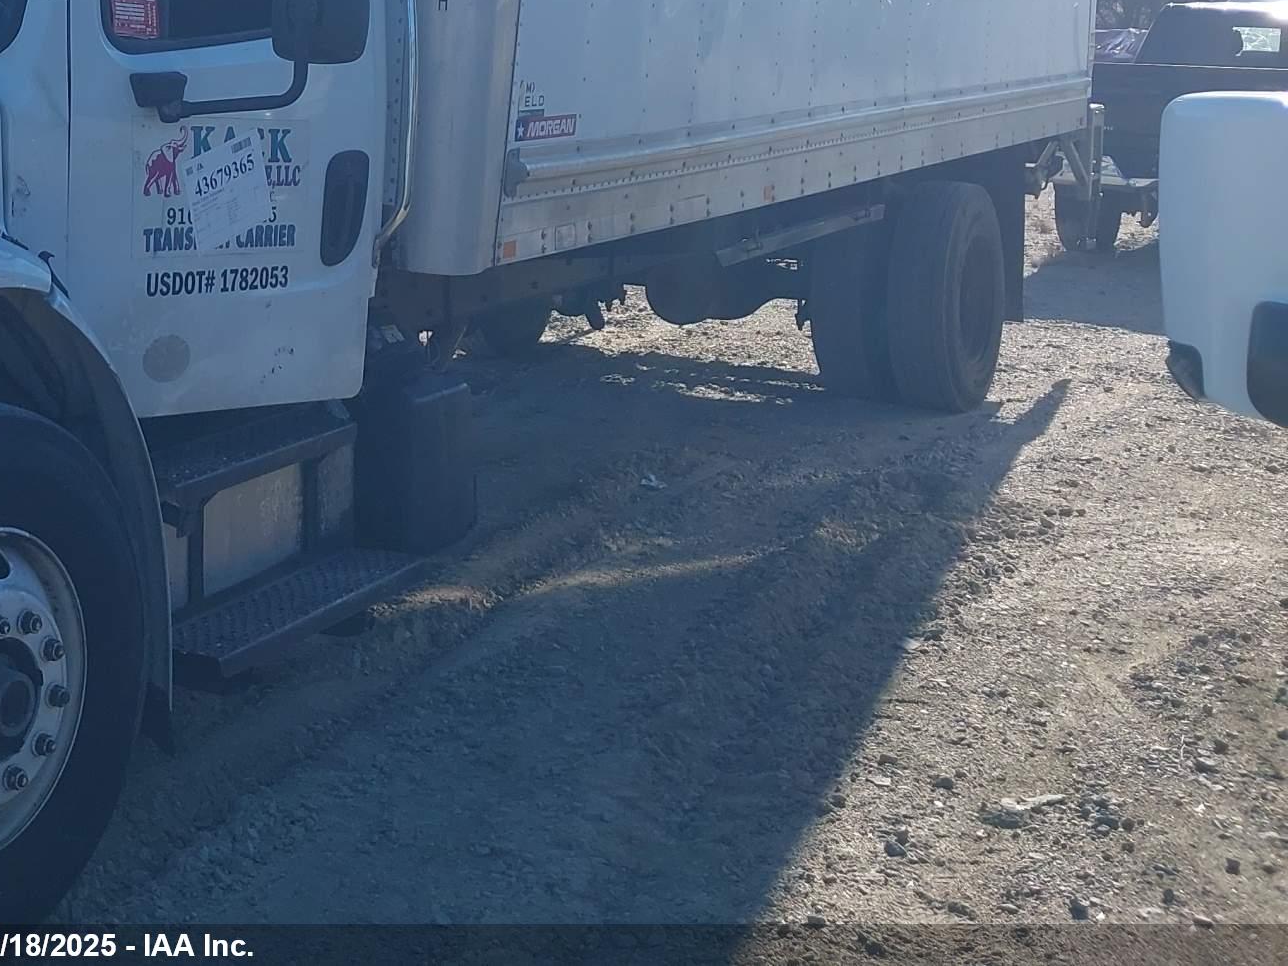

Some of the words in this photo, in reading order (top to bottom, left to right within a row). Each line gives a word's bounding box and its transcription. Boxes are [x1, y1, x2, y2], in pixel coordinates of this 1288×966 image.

[527, 118, 575, 138] MORGAN
[195, 154, 255, 196] 43679365
[146, 269, 216, 297] USDOT#
[220, 265, 289, 293] 1782053
